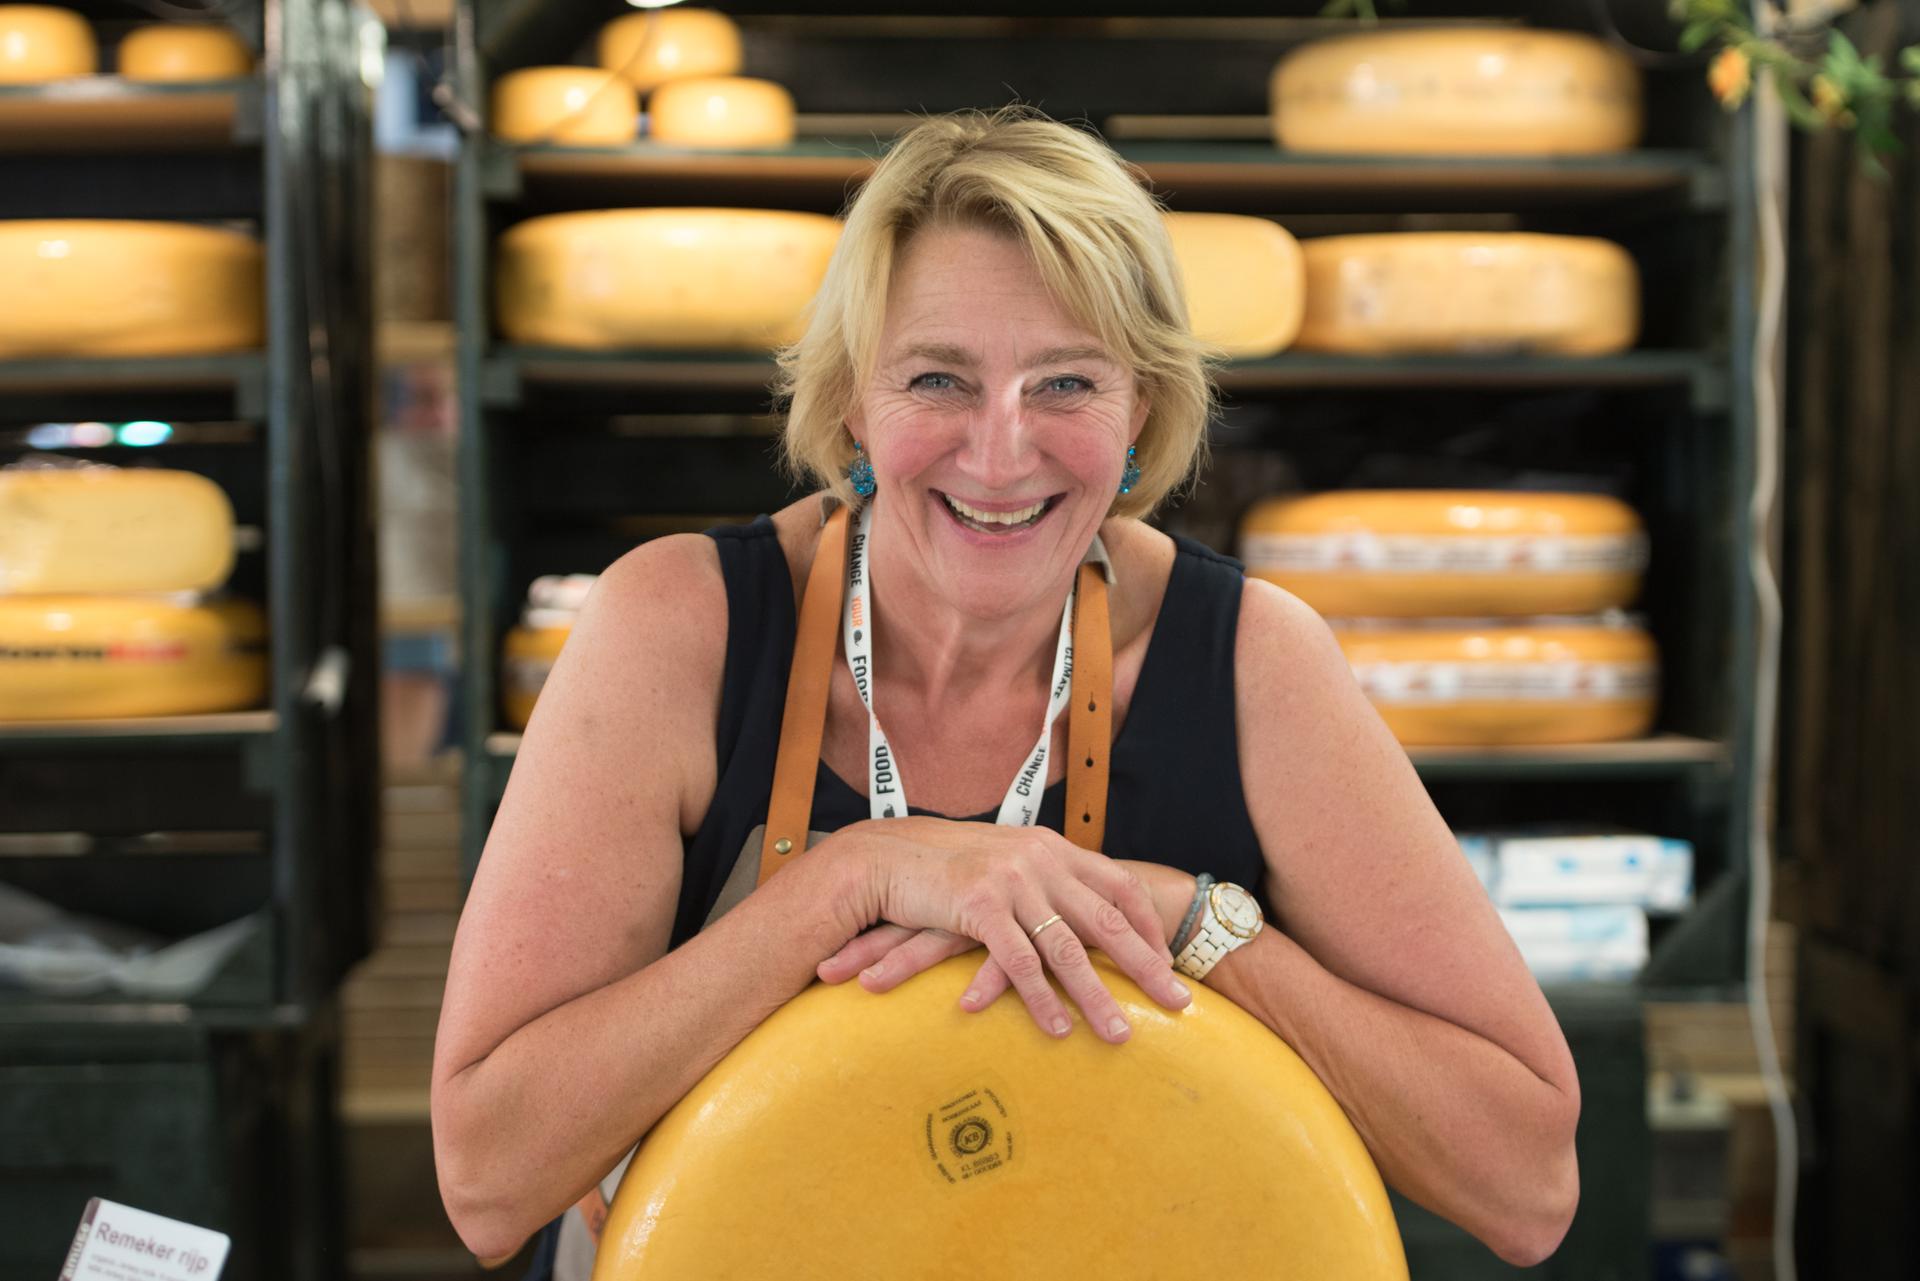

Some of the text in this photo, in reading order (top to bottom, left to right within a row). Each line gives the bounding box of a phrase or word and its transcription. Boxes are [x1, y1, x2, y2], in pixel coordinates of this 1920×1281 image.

[850, 533, 865, 588] CHANGE
[1054, 647, 1073, 699] CLIMATE
[96, 1222, 176, 1261] Remeker
[179, 1249, 209, 1274] rijp
